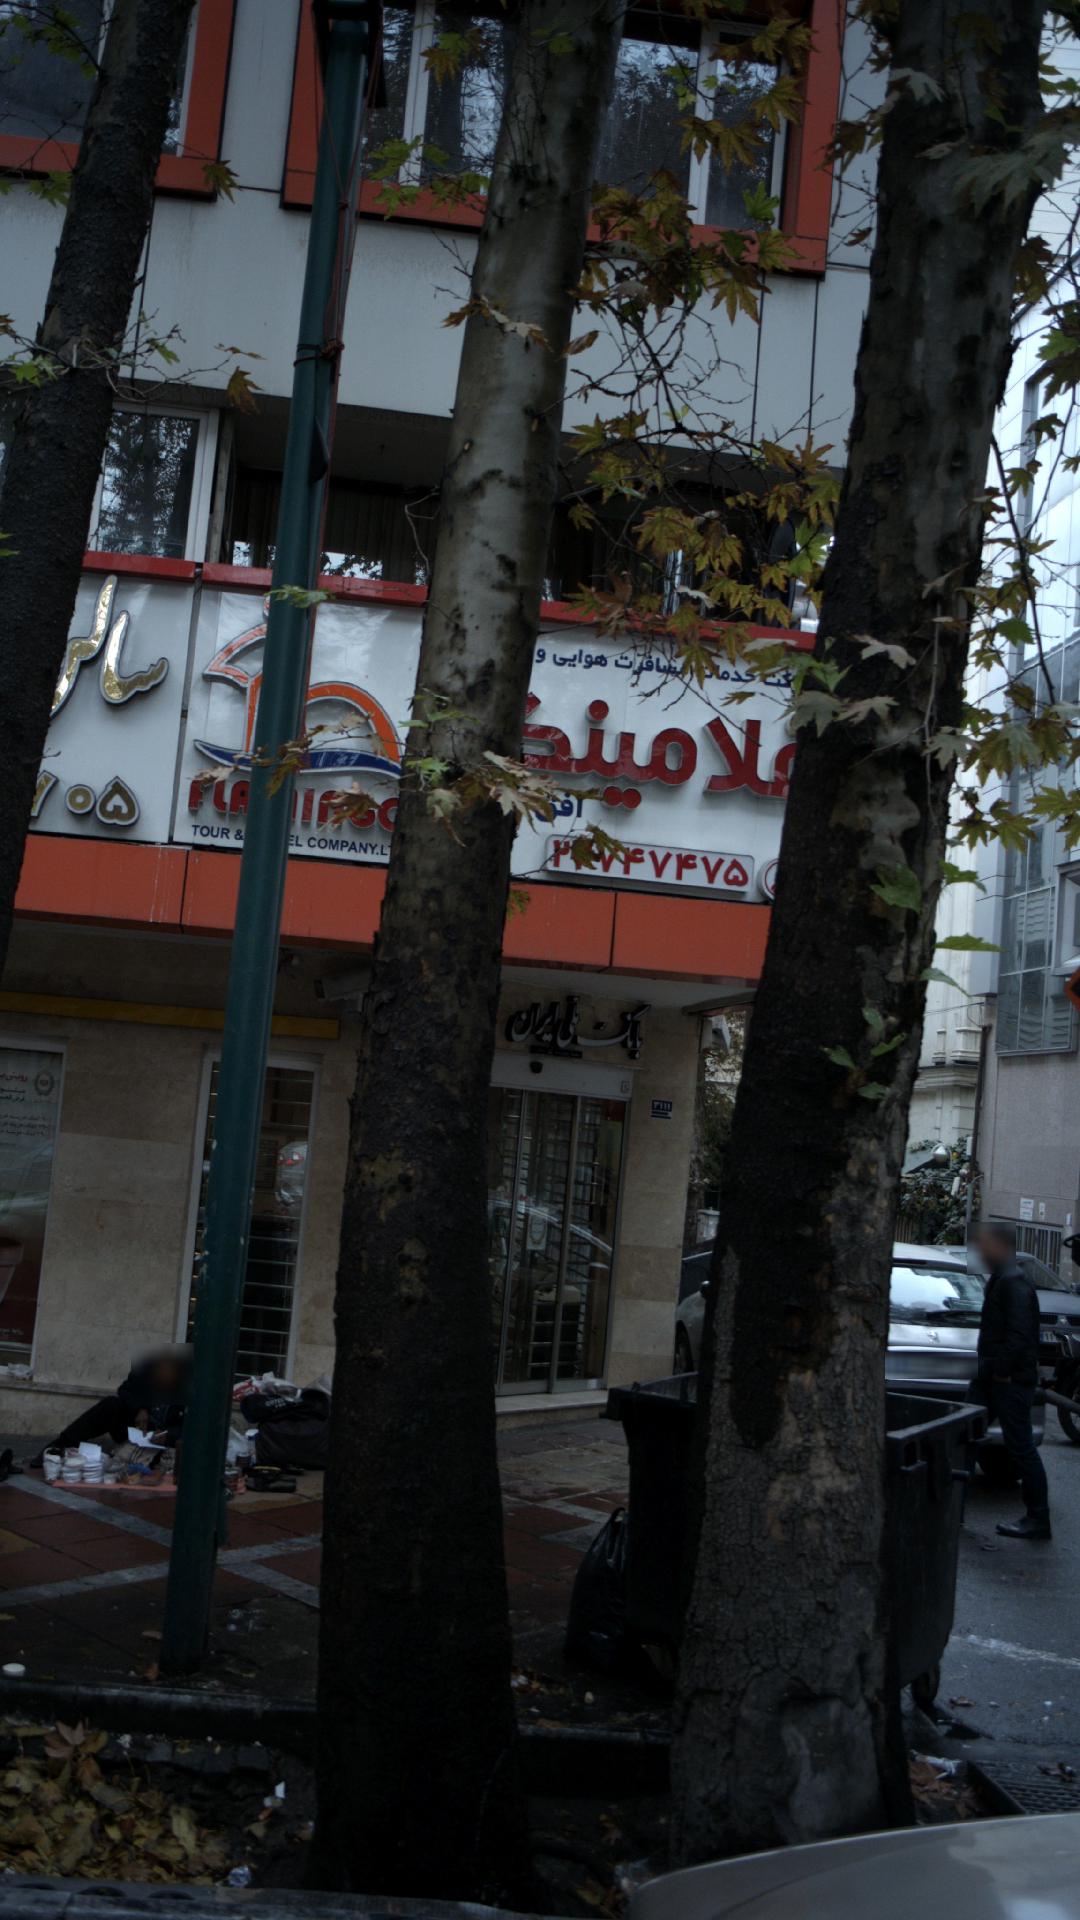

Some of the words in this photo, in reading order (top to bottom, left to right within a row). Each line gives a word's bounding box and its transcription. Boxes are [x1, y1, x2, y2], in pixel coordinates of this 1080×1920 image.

[535, 648, 546, 663] و
[552, 649, 608, 668] هوایی
[188, 779, 400, 833] FLAINGO
[191, 824, 230, 840] TOUR
[553, 839, 748, 887] ۲۷۴۷۴۷۵
